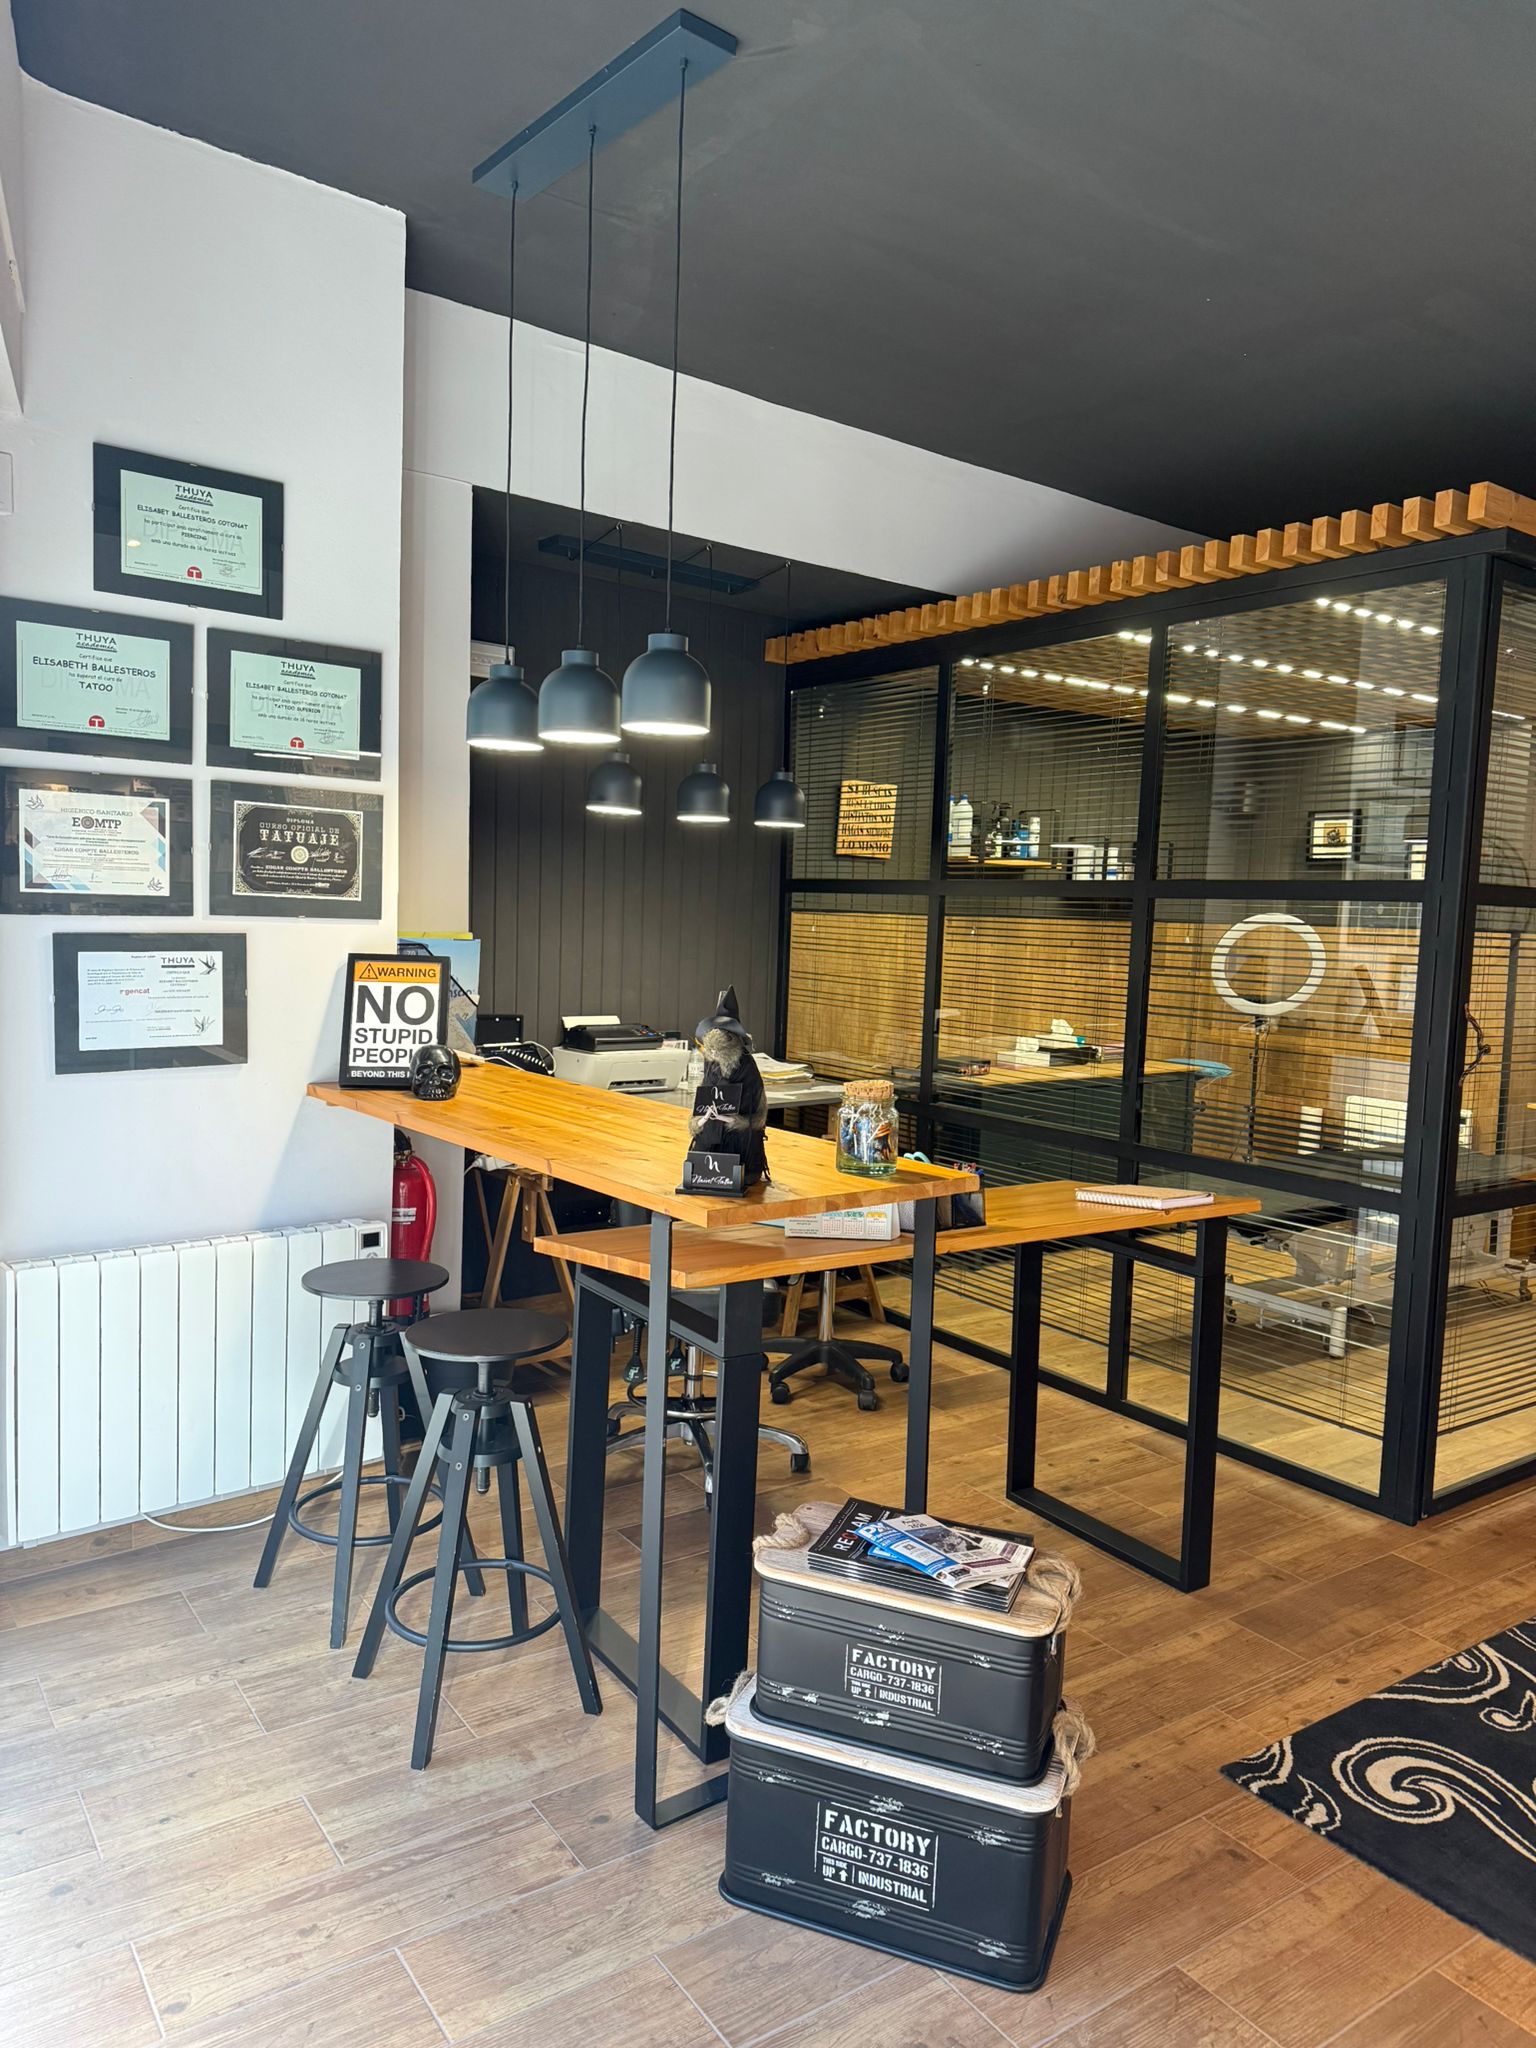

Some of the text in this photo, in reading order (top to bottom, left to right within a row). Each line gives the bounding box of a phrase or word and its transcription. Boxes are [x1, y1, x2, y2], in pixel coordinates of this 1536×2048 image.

[175, 485, 213, 499] THUYA
[137, 504, 248, 529] ELISABET BALLESTEROS COTONAT
[76, 633, 117, 645] THUYA
[33, 656, 156, 678] ELISABETH BALLESTEROS
[281, 661, 315, 673] THUYA
[79, 681, 113, 692] TATOO
[246, 682, 347, 700] ELISABET BALLESTEROS COTONAT
[259, 822, 287, 830] CURSO
[291, 825, 325, 833] OFICIAL
[259, 829, 339, 846] TATUAJE
[377, 967, 437, 978] WARNING
[355, 985, 435, 1025] NO
[354, 1028, 433, 1045] STUPID
[352, 1048, 413, 1063] PEOPL
[852, 1648, 936, 1680] FACTORY
[850, 1666, 935, 1695] CARGO-737-1836
[851, 1686, 933, 1711] UP INDUSTRIAL
[825, 1809, 931, 1856] FACTORY
[821, 1836, 929, 1879] CARGO-737-1836
[823, 1865, 927, 1903] UP INDUSTRIAL
